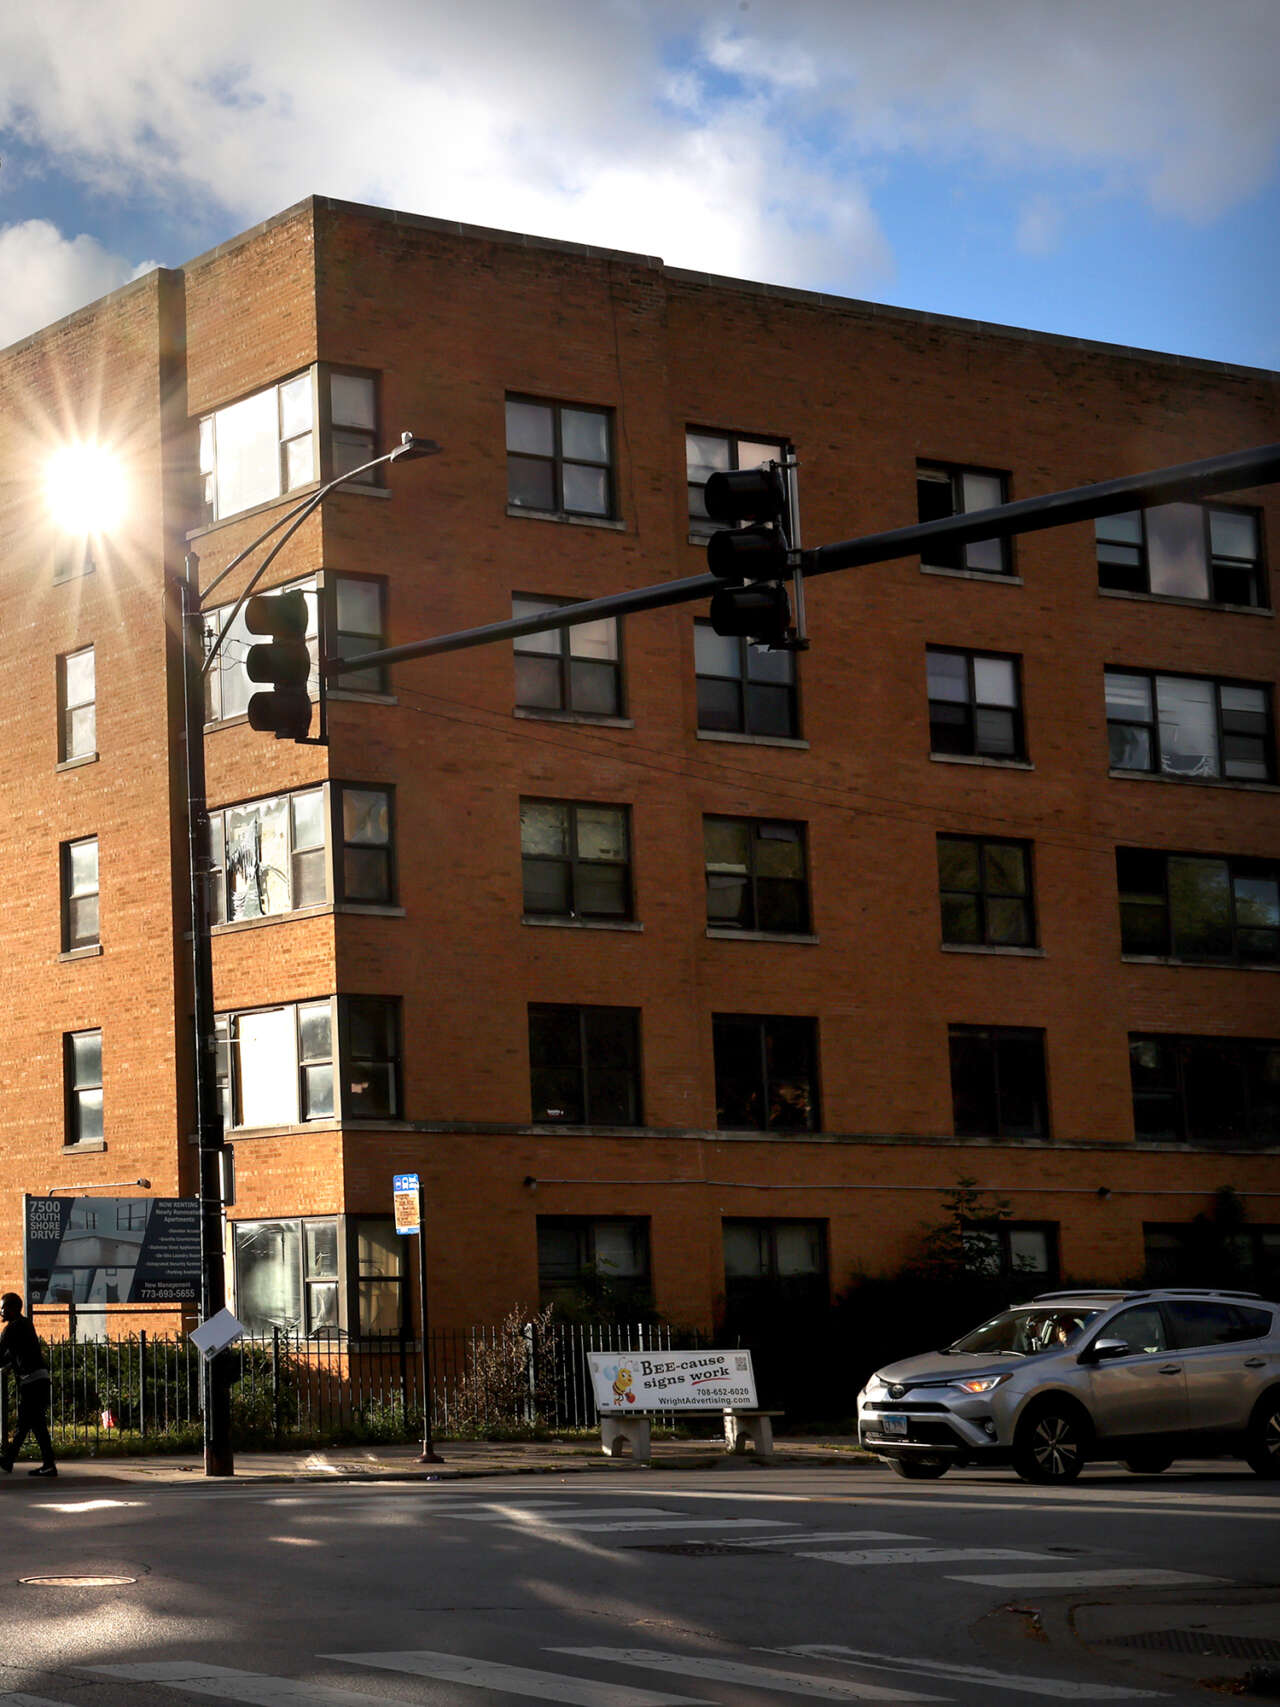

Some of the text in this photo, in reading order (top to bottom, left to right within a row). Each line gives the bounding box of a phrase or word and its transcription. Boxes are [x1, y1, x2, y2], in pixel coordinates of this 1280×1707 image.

[29, 1201, 61, 1213] 7500
[30, 1213, 61, 1222] SOUTH
[30, 1222, 61, 1231] SHORE
[30, 1230, 61, 1240] DRIVE
[643, 1366, 730, 1390] signs work
[658, 1396, 752, 1407] WrightAdvertising.com
